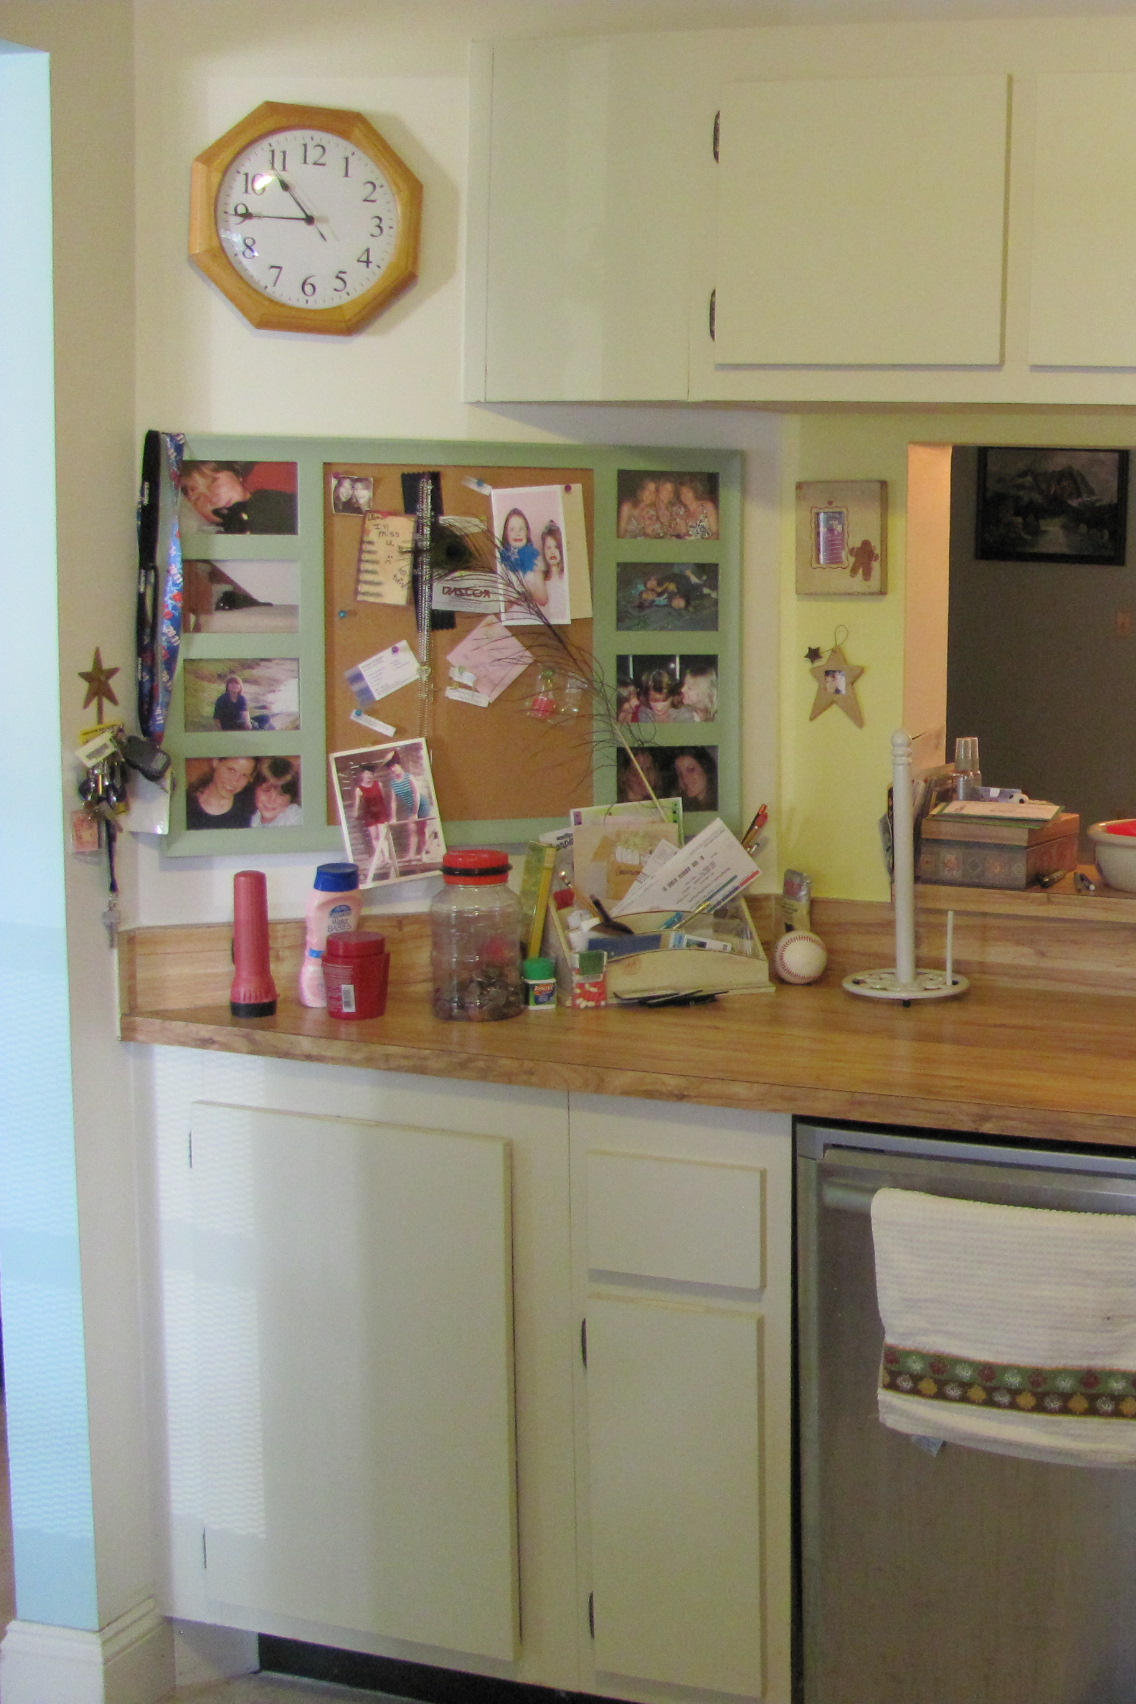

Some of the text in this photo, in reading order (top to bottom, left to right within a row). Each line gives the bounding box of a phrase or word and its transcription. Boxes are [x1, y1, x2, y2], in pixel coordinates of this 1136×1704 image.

[270, 149, 288, 171] 11
[302, 143, 326, 166] 12
[343, 156, 351, 178] 1
[362, 181, 377, 203] 2
[234, 203, 250, 225] 9
[370, 216, 383, 237] 3
[242, 237, 256, 259] 8
[357, 248, 372, 268] 4
[269, 266, 283, 287] 7
[301, 275, 316, 296] 6
[333, 271, 347, 292] 5
